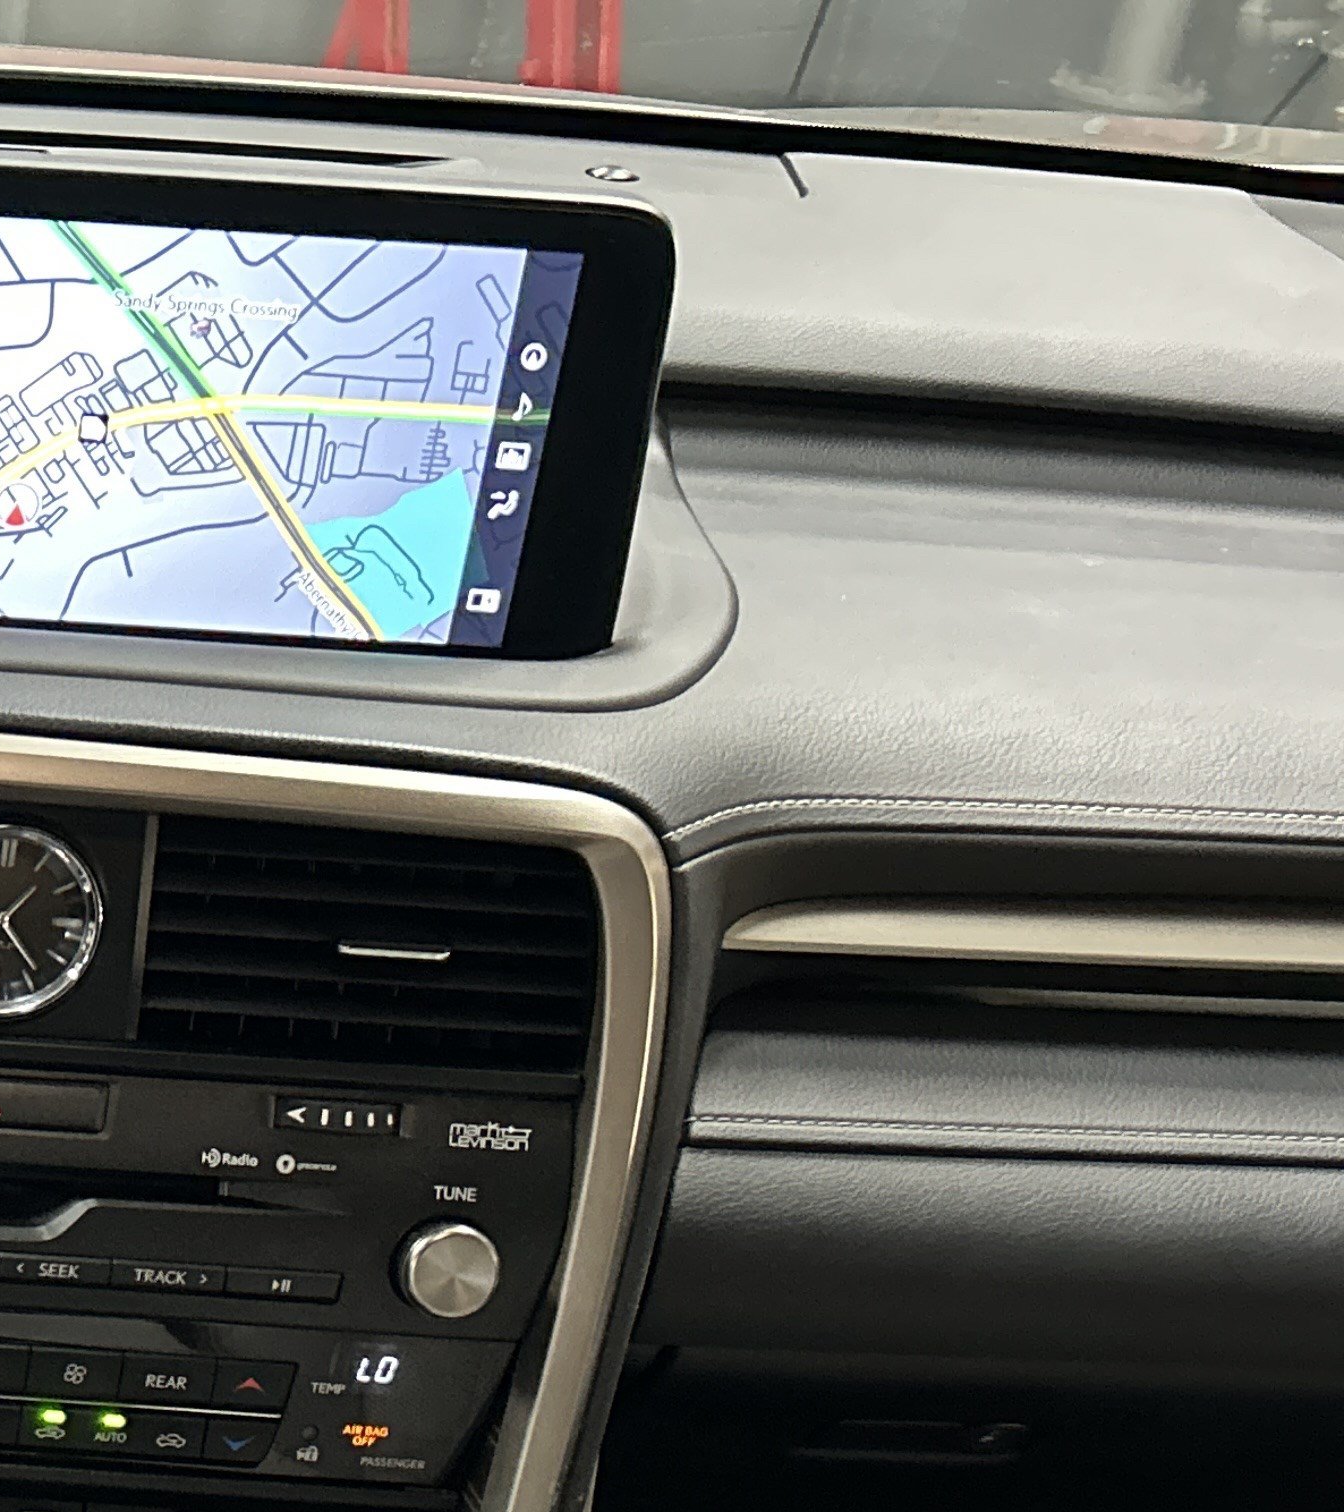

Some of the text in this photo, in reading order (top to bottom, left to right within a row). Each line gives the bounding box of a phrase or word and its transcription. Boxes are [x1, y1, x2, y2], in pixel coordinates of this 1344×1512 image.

[114, 290, 298, 322] Sandy Springs Crossing
[298, 571, 351, 634] Abernathy
[222, 1151, 259, 1167] Radio
[433, 1184, 478, 1203] TUNE
[37, 1261, 80, 1280] SEEK
[133, 1267, 188, 1286] TRACK
[355, 1355, 400, 1385] LO
[144, 1373, 188, 1391] REAR
[311, 1381, 346, 1396] TEMP
[93, 1430, 128, 1444] AUTO
[342, 1423, 390, 1438] AIR BAG
[351, 1436, 378, 1448] OFF
[359, 1455, 427, 1471] PASSENGER
